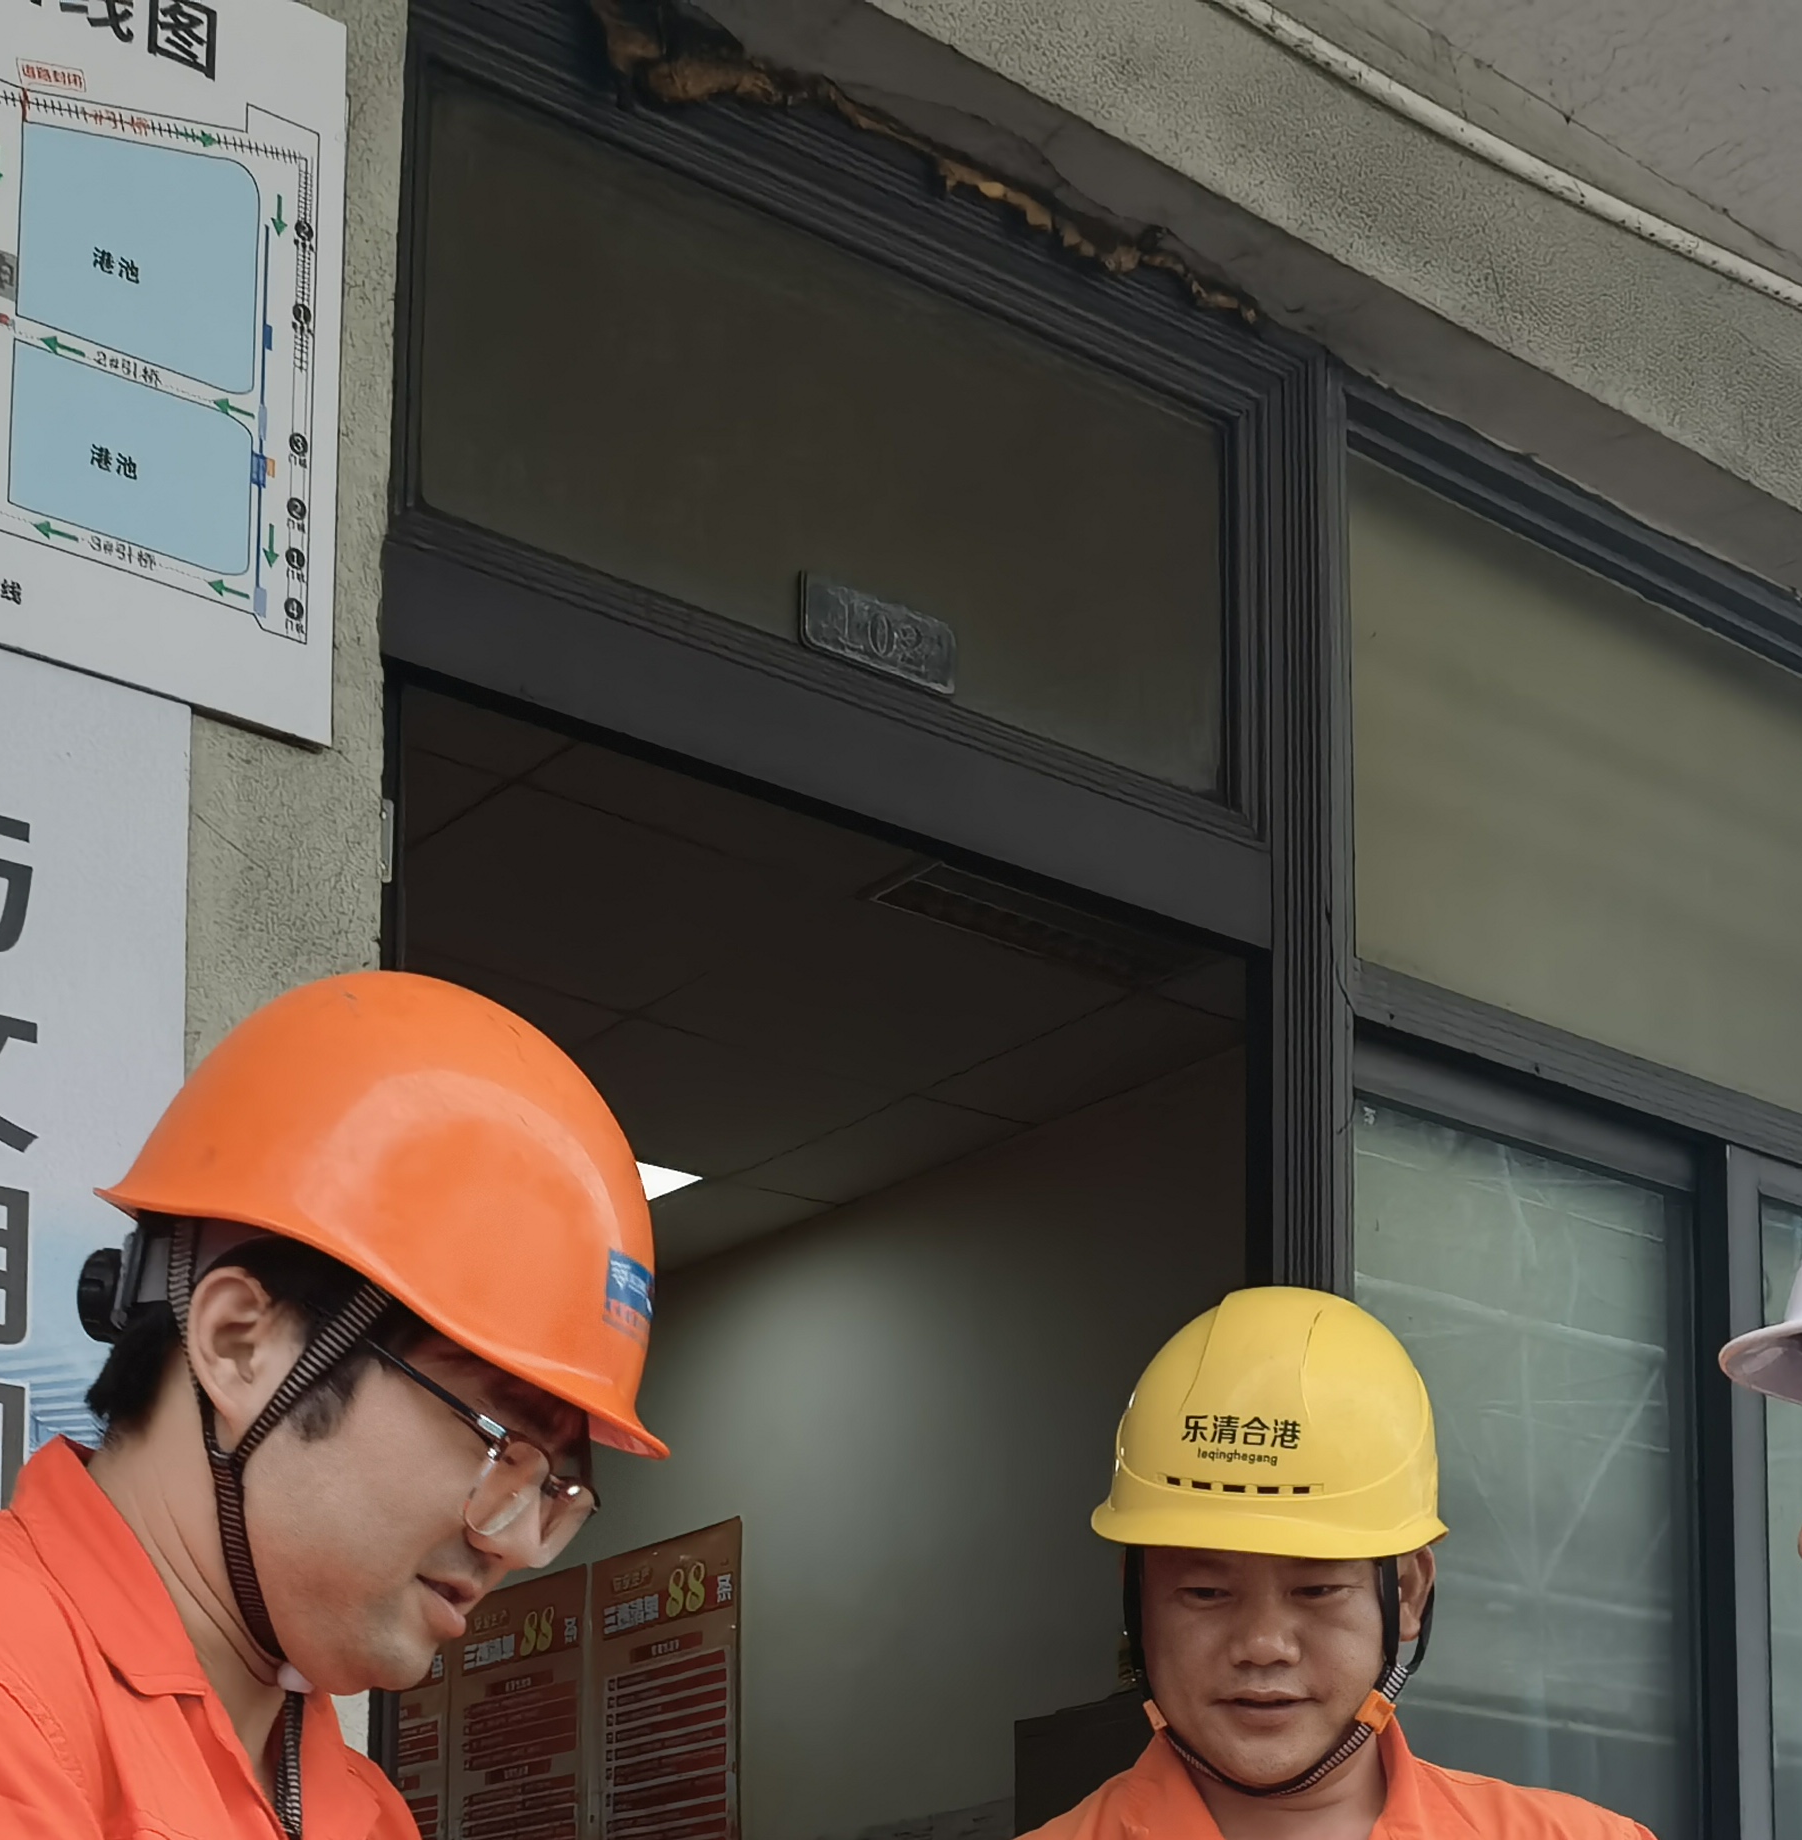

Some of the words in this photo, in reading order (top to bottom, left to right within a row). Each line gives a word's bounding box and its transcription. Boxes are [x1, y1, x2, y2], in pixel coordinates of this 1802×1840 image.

[93, 246, 140, 284] 港池
[90, 443, 139, 480] 港池
[1181, 1414, 1302, 1449] 乐清合港
